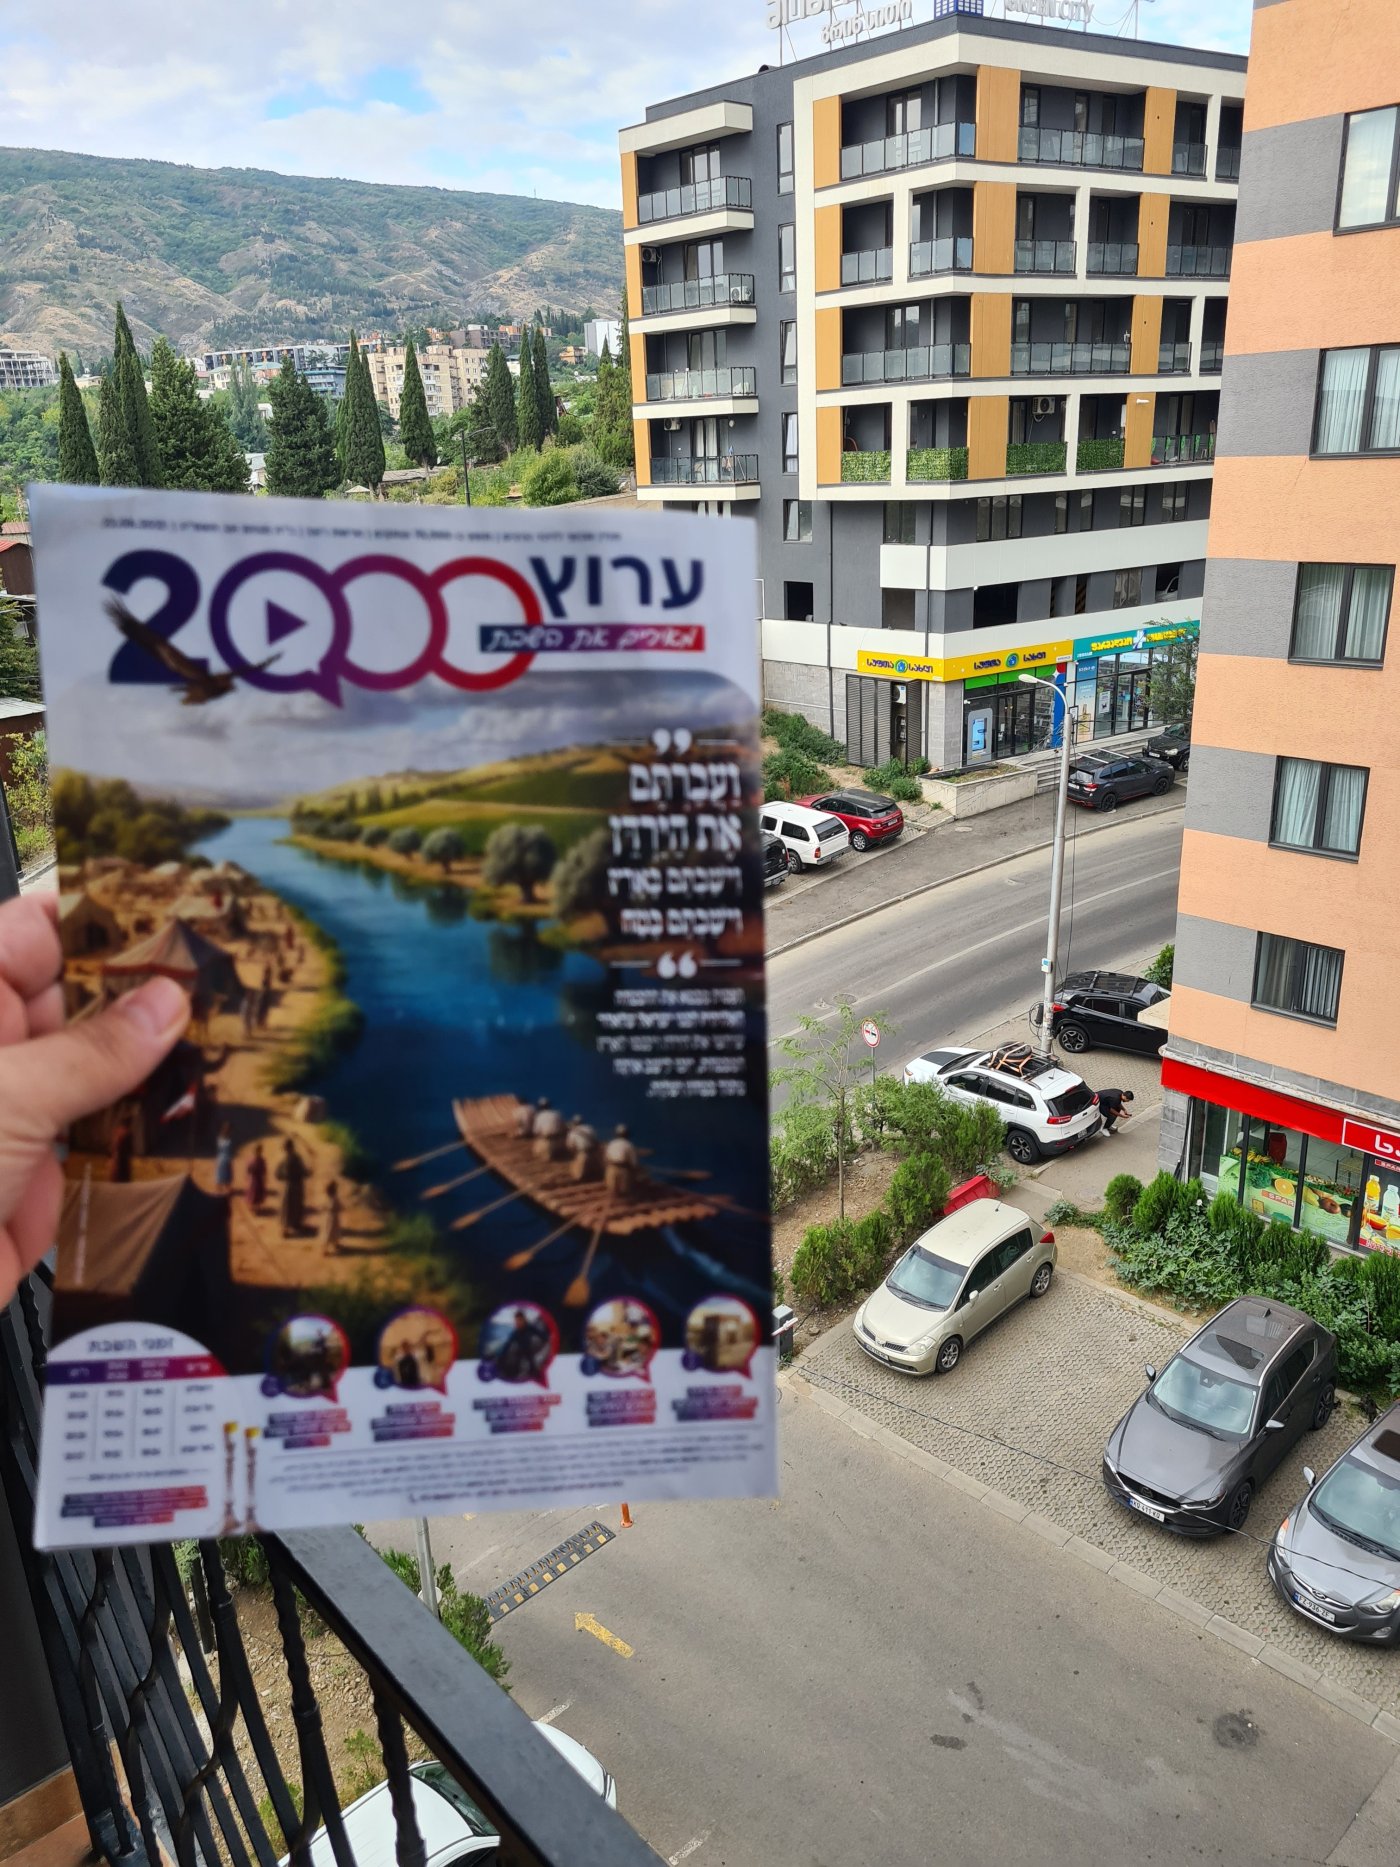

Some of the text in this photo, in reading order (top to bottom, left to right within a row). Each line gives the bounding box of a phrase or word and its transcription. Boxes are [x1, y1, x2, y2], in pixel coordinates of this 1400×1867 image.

[530, 555, 704, 618] ערוץ
[487, 625, 564, 650] השבת
[569, 627, 610, 650] את
[1268, 1191, 1295, 1208] SPAR
